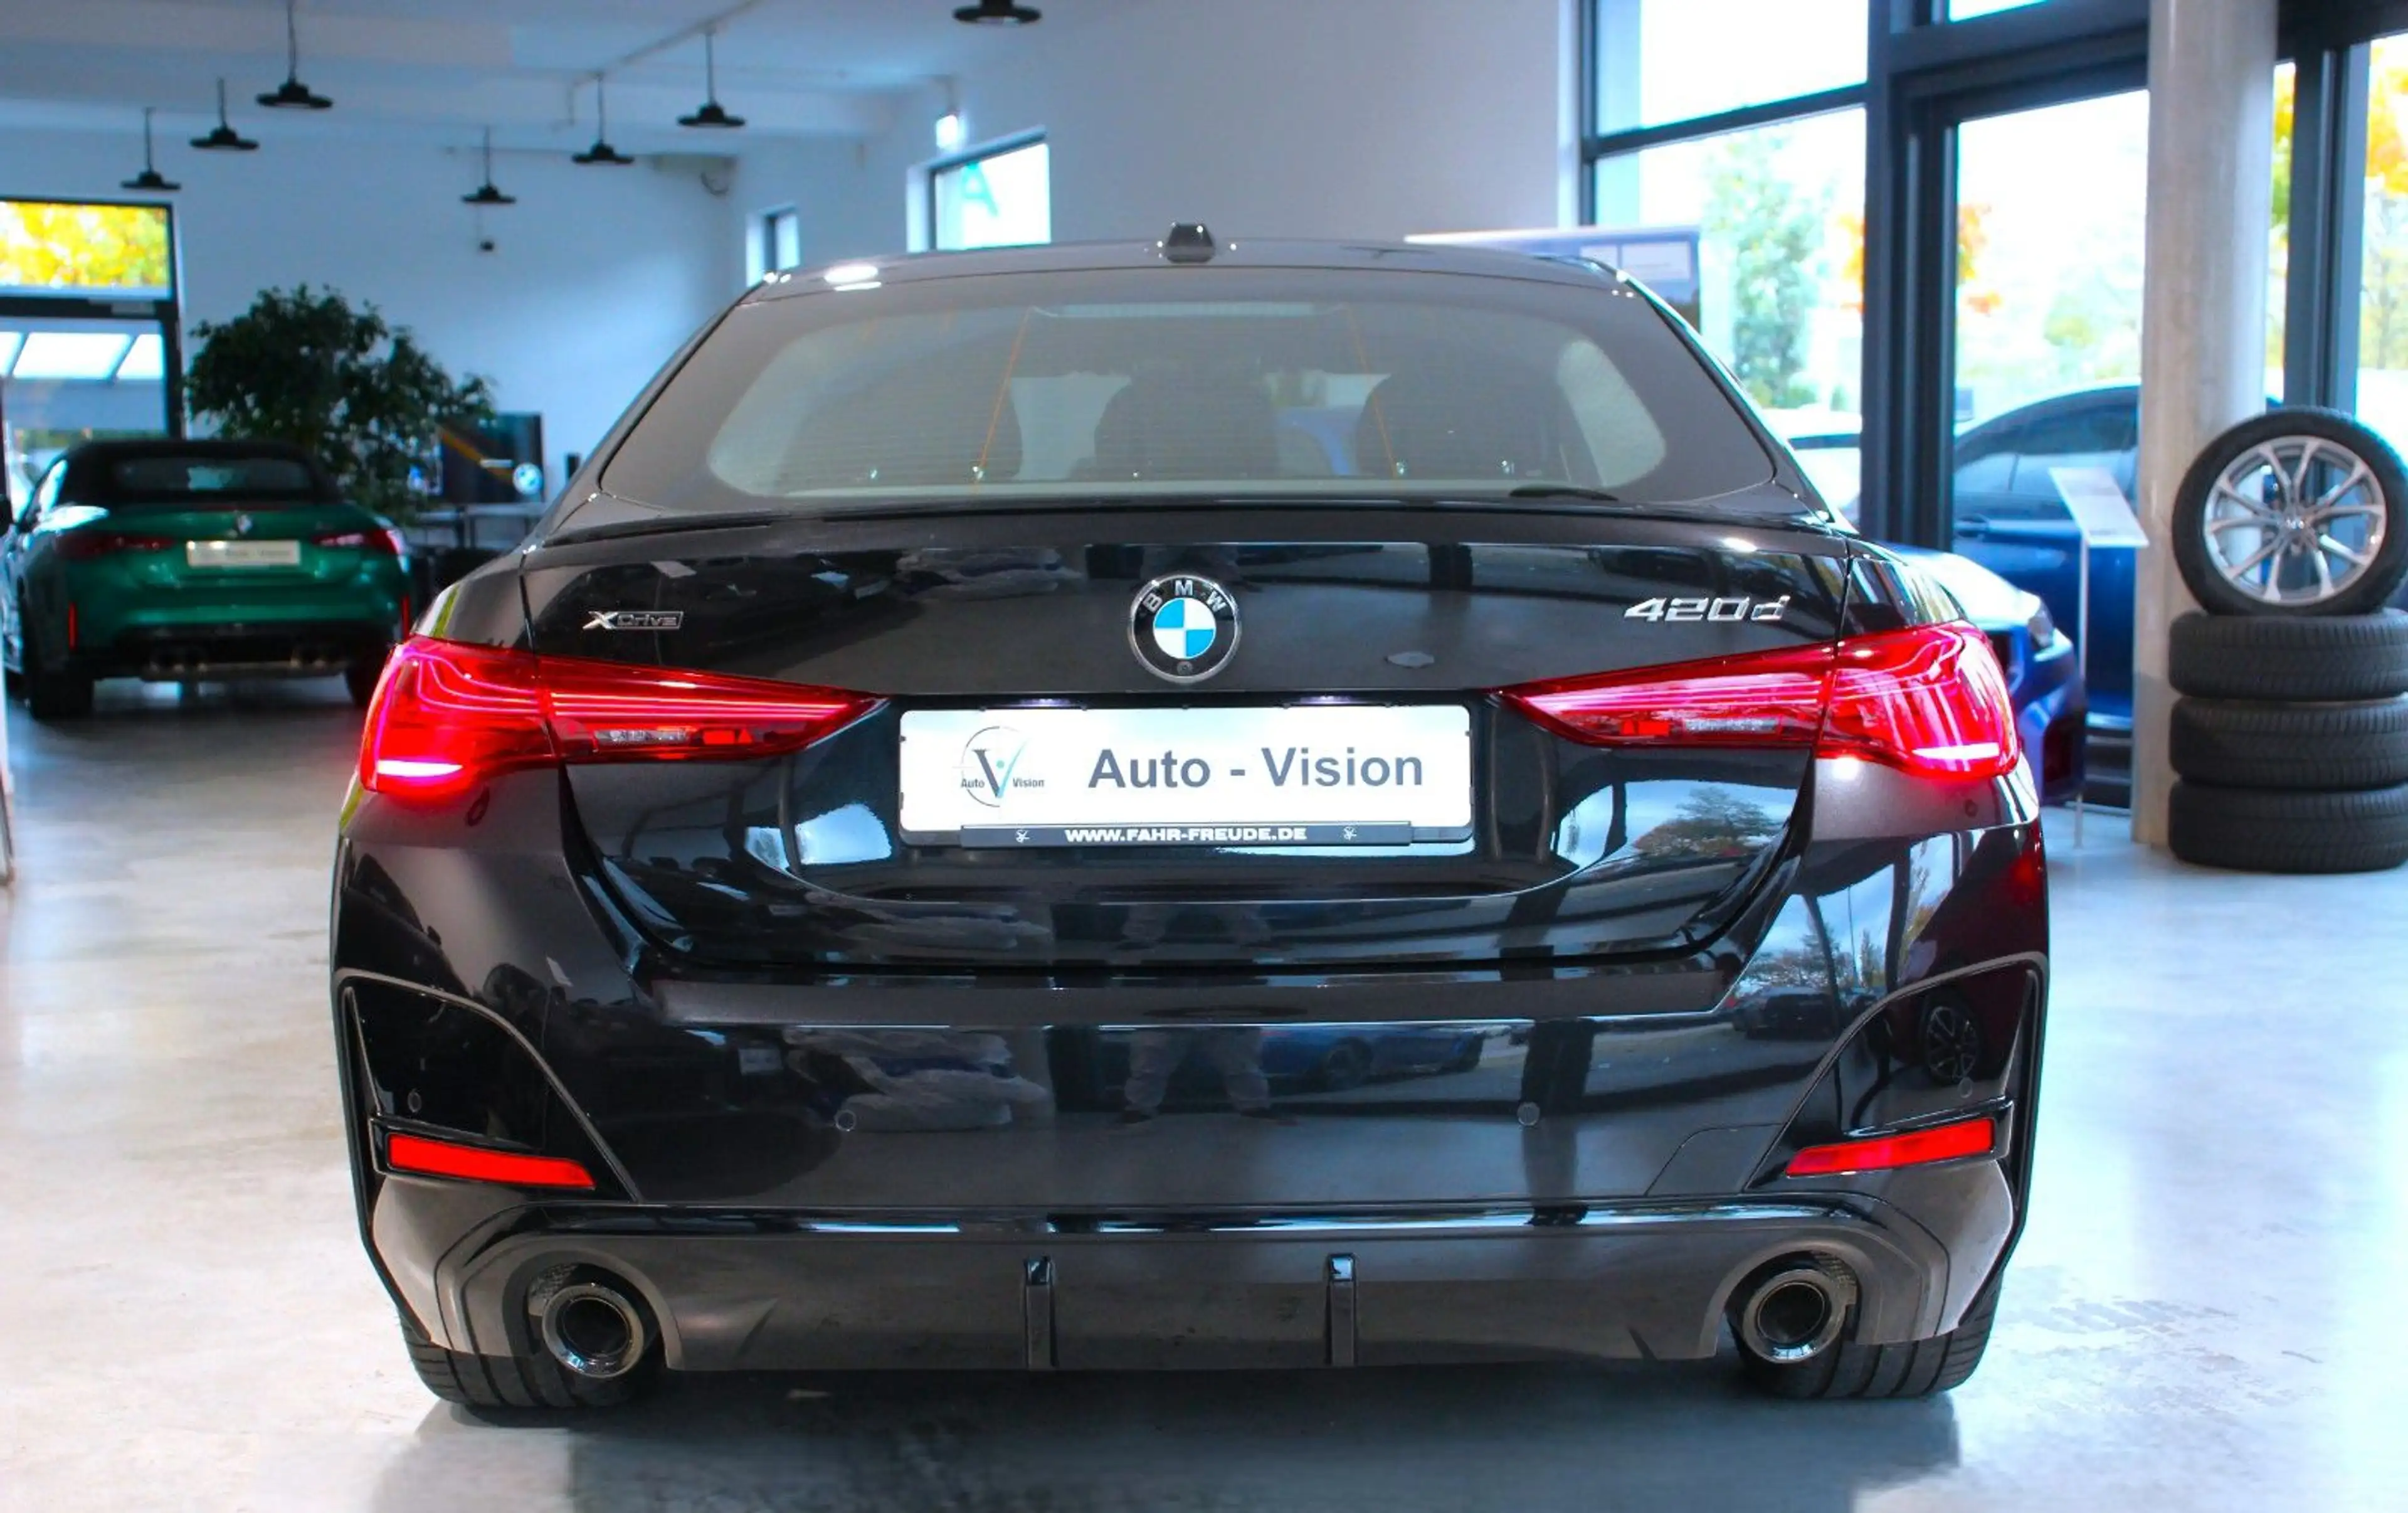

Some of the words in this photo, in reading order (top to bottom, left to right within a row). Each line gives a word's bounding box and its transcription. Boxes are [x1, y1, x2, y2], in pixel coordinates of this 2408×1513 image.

[1143, 580, 1227, 613] BMW
[1624, 595, 1791, 622] 420d
[1087, 748, 1212, 788] Auto
[1261, 746, 1423, 787] Vision
[961, 778, 985, 788] Auto
[1012, 777, 1045, 788] Vision
[1065, 827, 1307, 842] WWW.FAHR-FREUDE.DE
